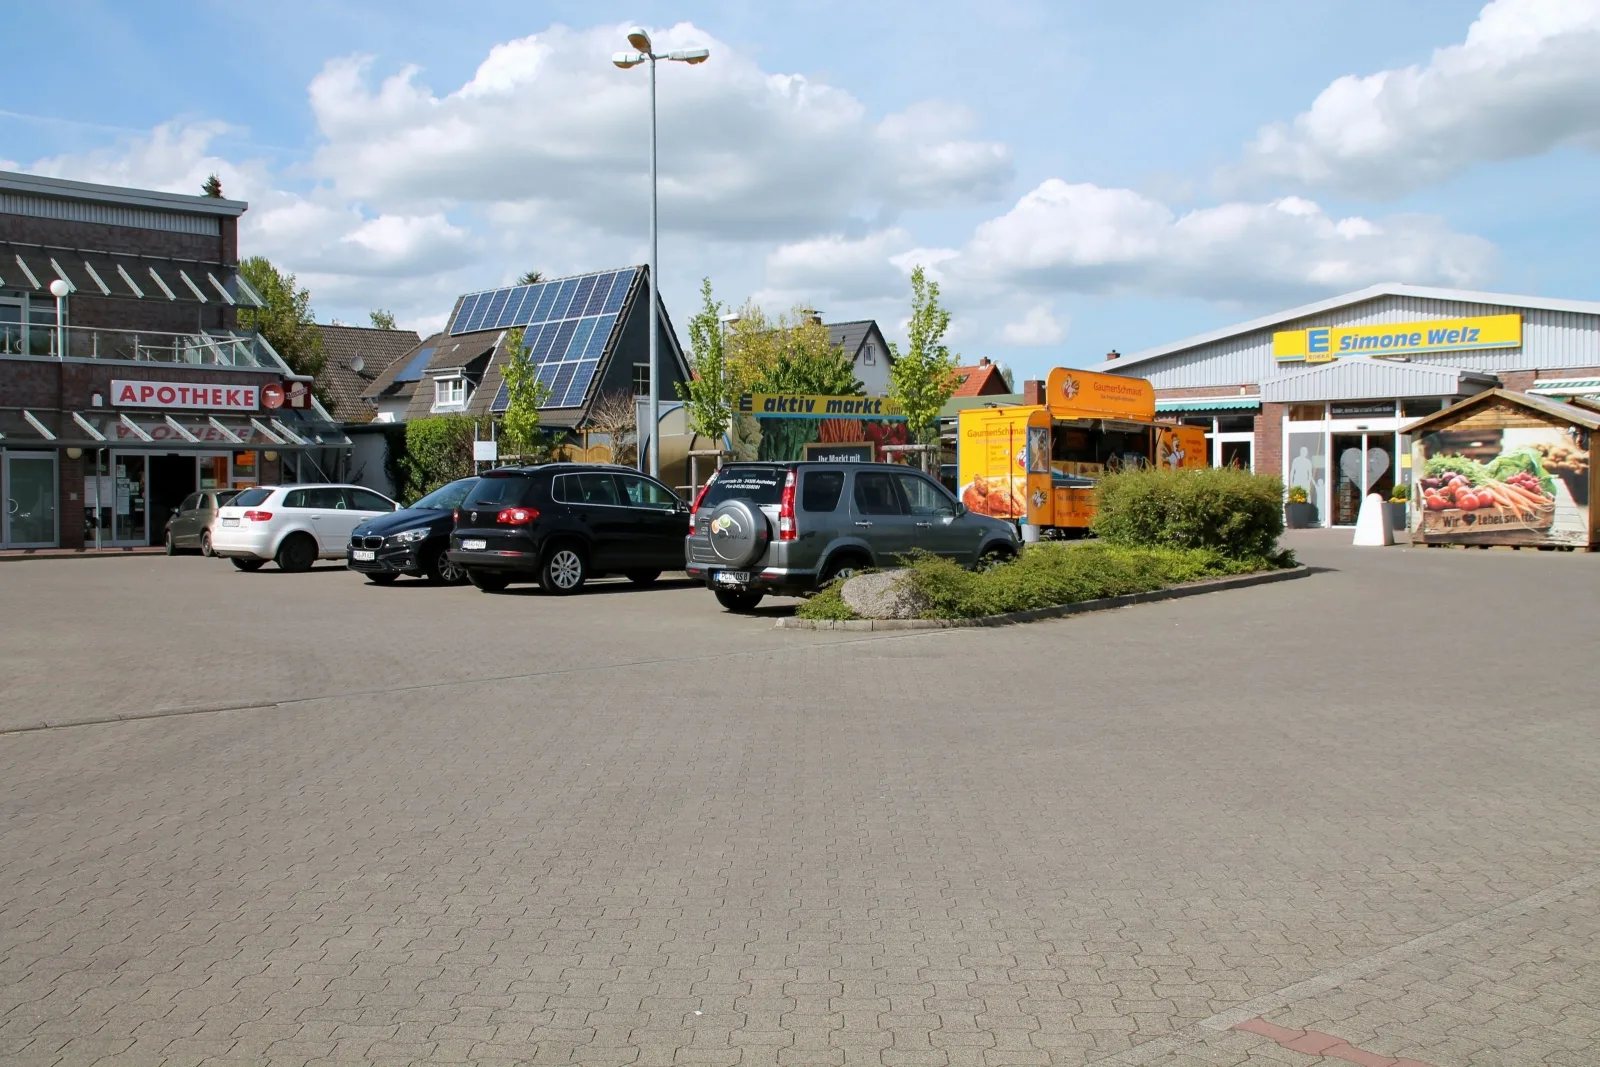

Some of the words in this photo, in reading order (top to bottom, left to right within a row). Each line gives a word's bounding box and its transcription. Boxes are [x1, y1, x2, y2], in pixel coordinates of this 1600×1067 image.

[1308, 329, 1329, 353] E
[1339, 332, 1422, 351] Simone
[1427, 326, 1480, 345] Welz
[119, 385, 254, 407] APOTHEKE
[1093, 380, 1142, 397] GaumenSchmaus
[763, 396, 816, 413] aktiv
[825, 398, 882, 414] markt
[967, 428, 1027, 438] GaumenSchmau
[828, 454, 848, 462] Markt
[850, 454, 860, 462] mit
[1442, 516, 1460, 527] Wir
